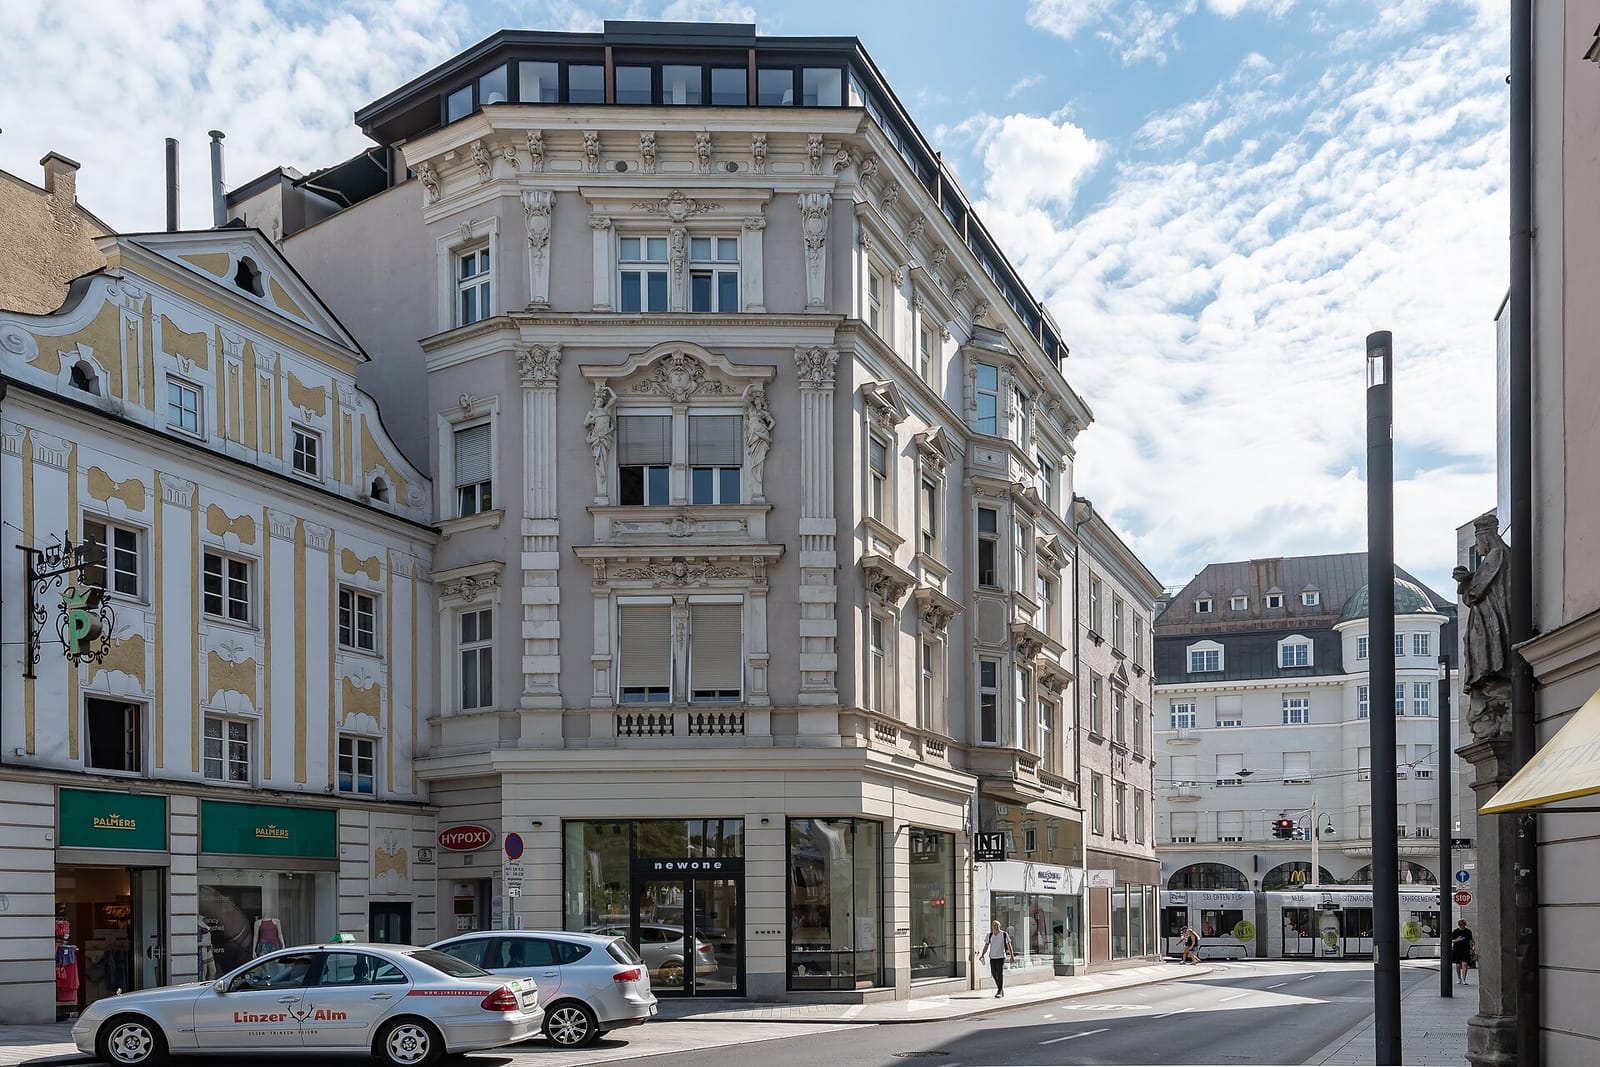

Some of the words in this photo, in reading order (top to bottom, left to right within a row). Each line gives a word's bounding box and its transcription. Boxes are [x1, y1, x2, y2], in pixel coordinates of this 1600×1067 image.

[69, 610, 91, 654] P
[93, 817, 136, 827] PALMERS
[255, 827, 289, 837] PALMERS
[441, 832, 486, 844] HYPOXI
[654, 861, 722, 870] newone
[1455, 894, 1471, 902] STOP
[233, 1011, 287, 1024] Linzer
[314, 1009, 347, 1021] Alm
